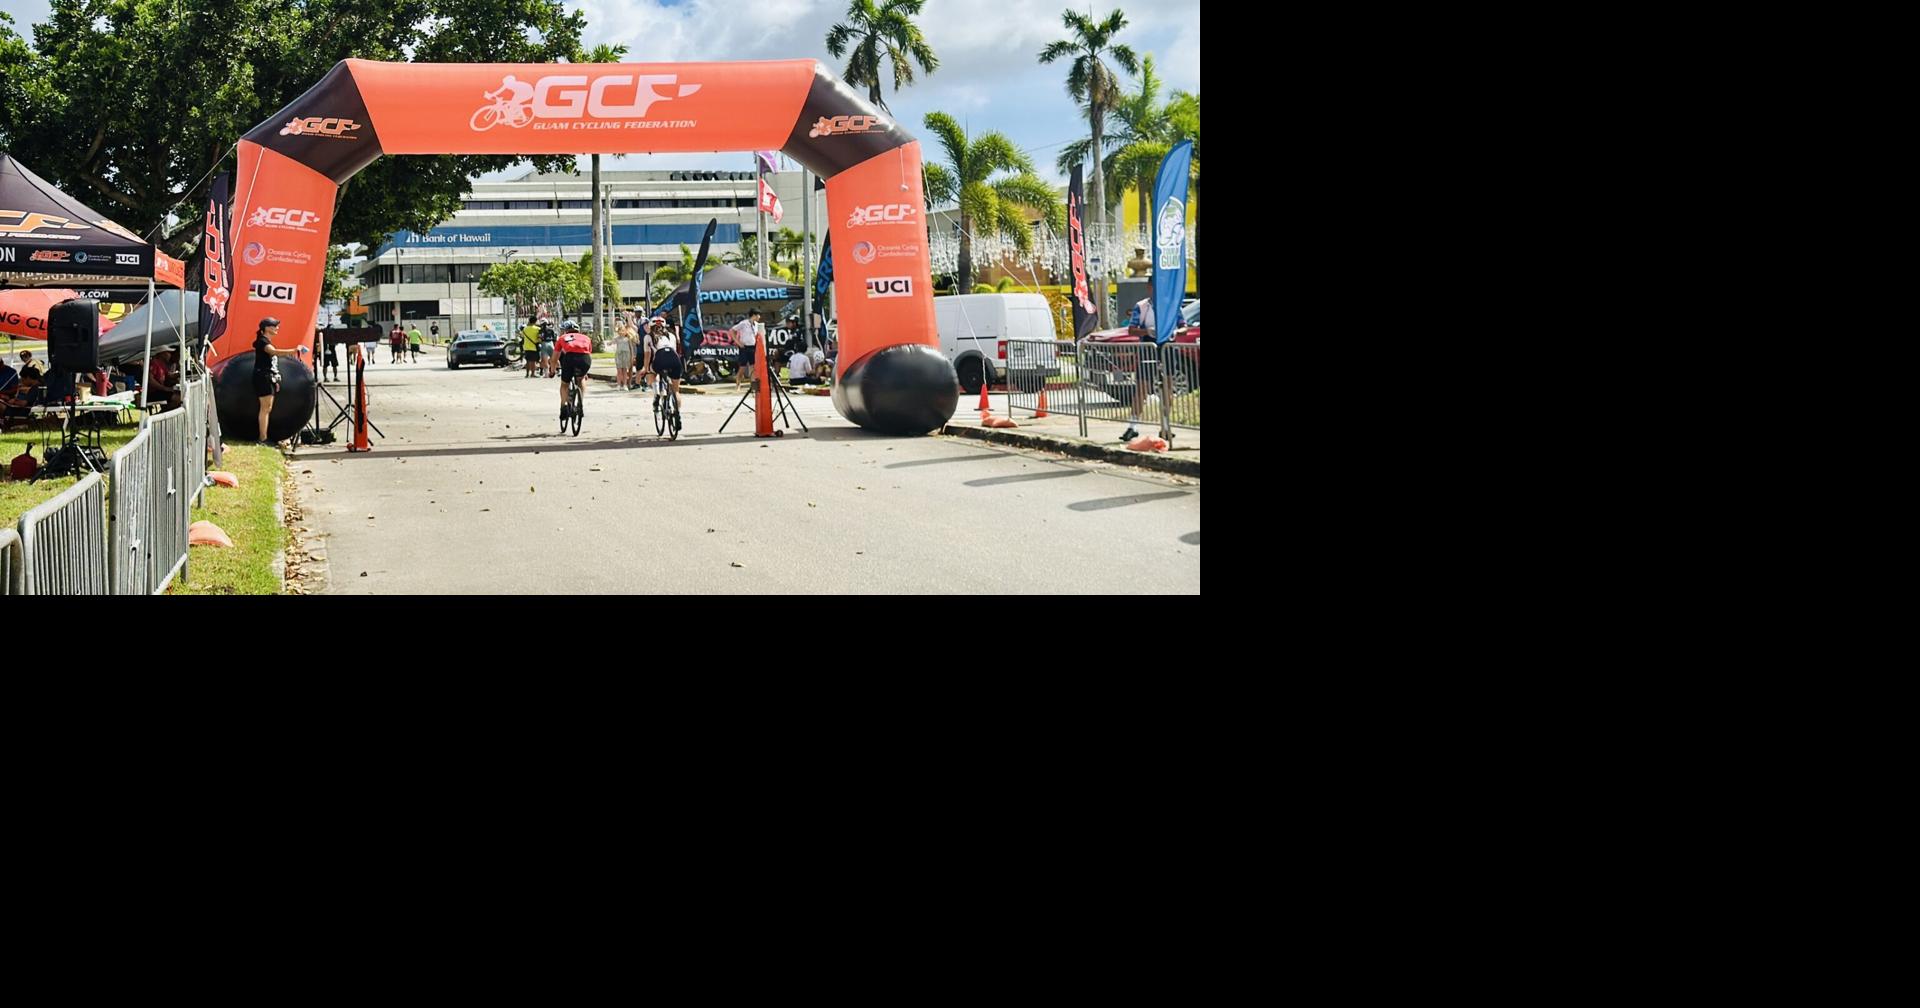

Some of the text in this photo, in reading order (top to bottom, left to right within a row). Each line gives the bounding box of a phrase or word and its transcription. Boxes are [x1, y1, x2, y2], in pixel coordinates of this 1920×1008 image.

[534, 74, 702, 119] GCF
[303, 117, 361, 135] GCF
[533, 119, 698, 130] GUAM CYCLING FEDERATION
[831, 115, 882, 131] GCF
[267, 207, 320, 227] GCF
[865, 204, 916, 221] GCF
[422, 233, 491, 243] Bank of Hawaii
[119, 255, 138, 263] UCI
[76, 291, 109, 299] R.COM
[257, 284, 293, 300] UCI
[700, 287, 789, 303] POWERADE
[874, 280, 910, 294] UCI
[694, 347, 740, 356] MORE THAN
